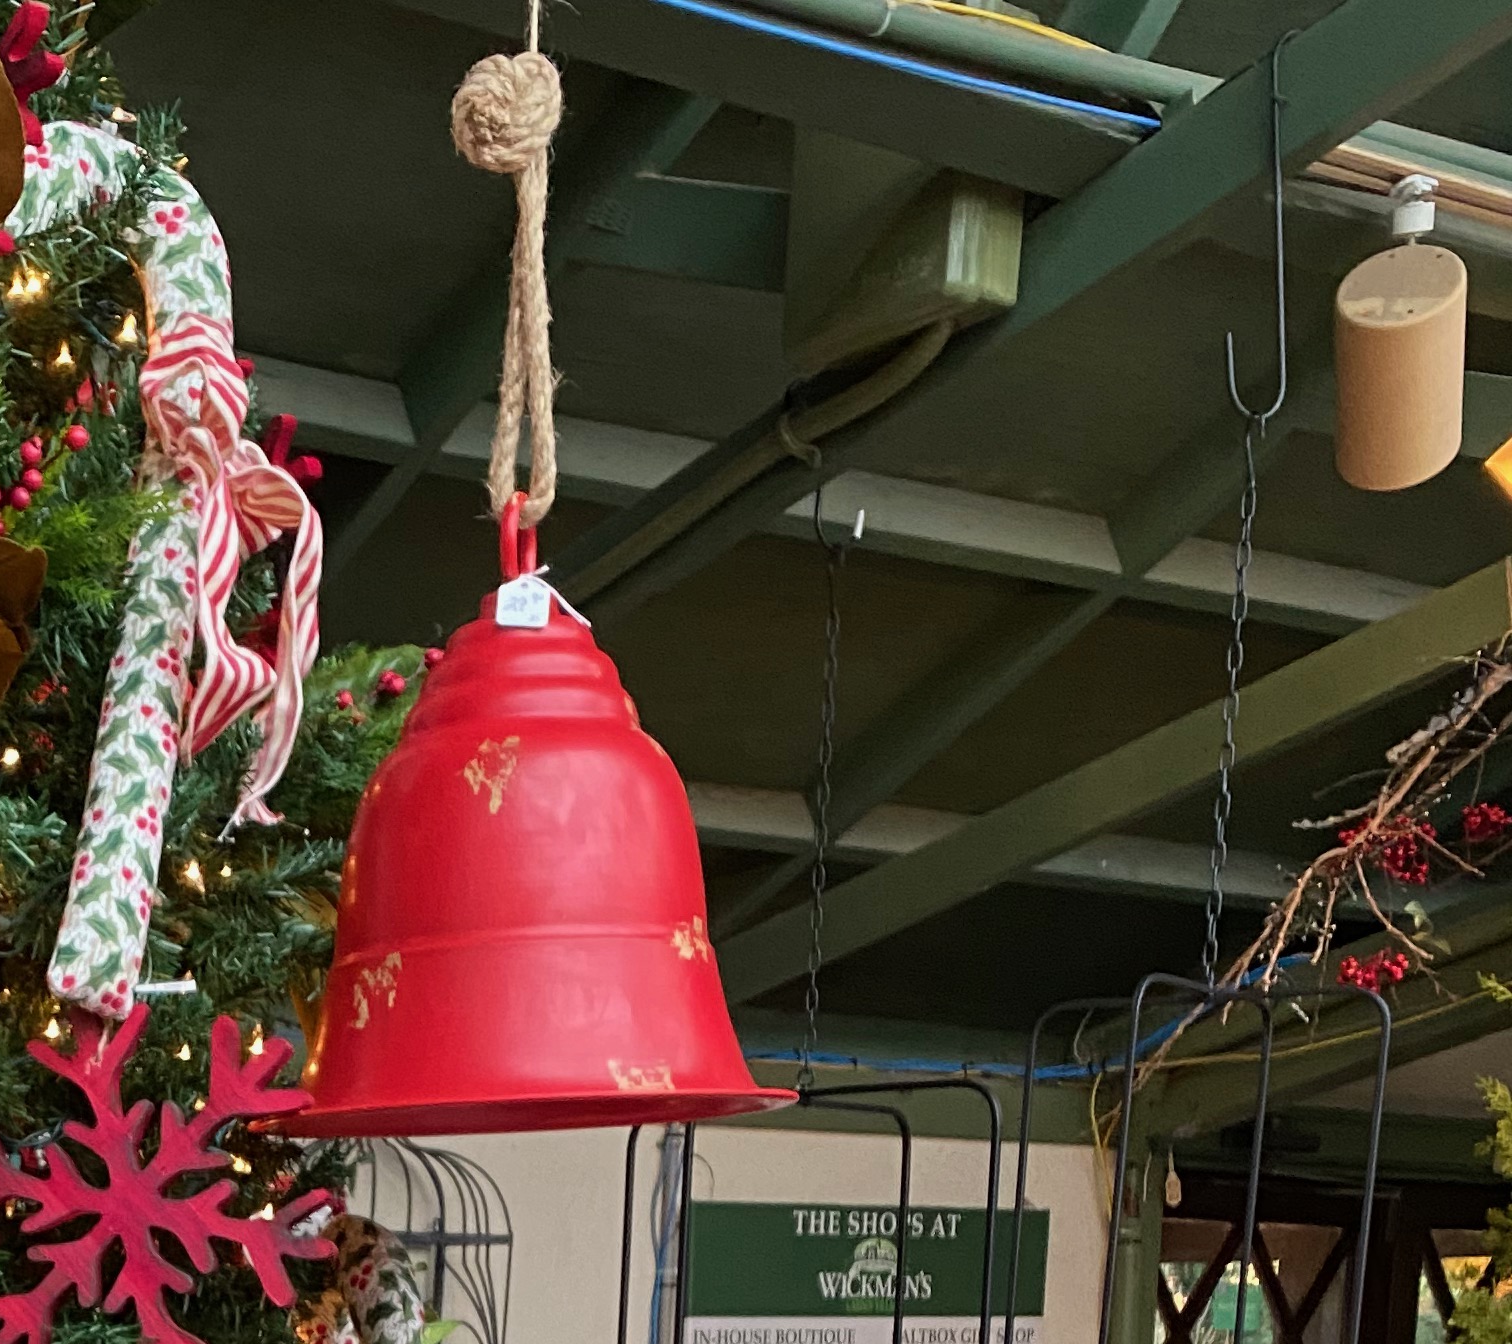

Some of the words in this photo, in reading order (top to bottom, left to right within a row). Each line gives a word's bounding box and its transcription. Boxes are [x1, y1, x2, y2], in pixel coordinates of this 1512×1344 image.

[793, 1209, 841, 1236] THE
[847, 1211, 924, 1238] SHOS
[931, 1213, 962, 1239] AT
[819, 1270, 933, 1300] WICKMN'S
[899, 1327, 957, 1344] ALTBOX
[997, 1328, 1034, 1344] SOP
